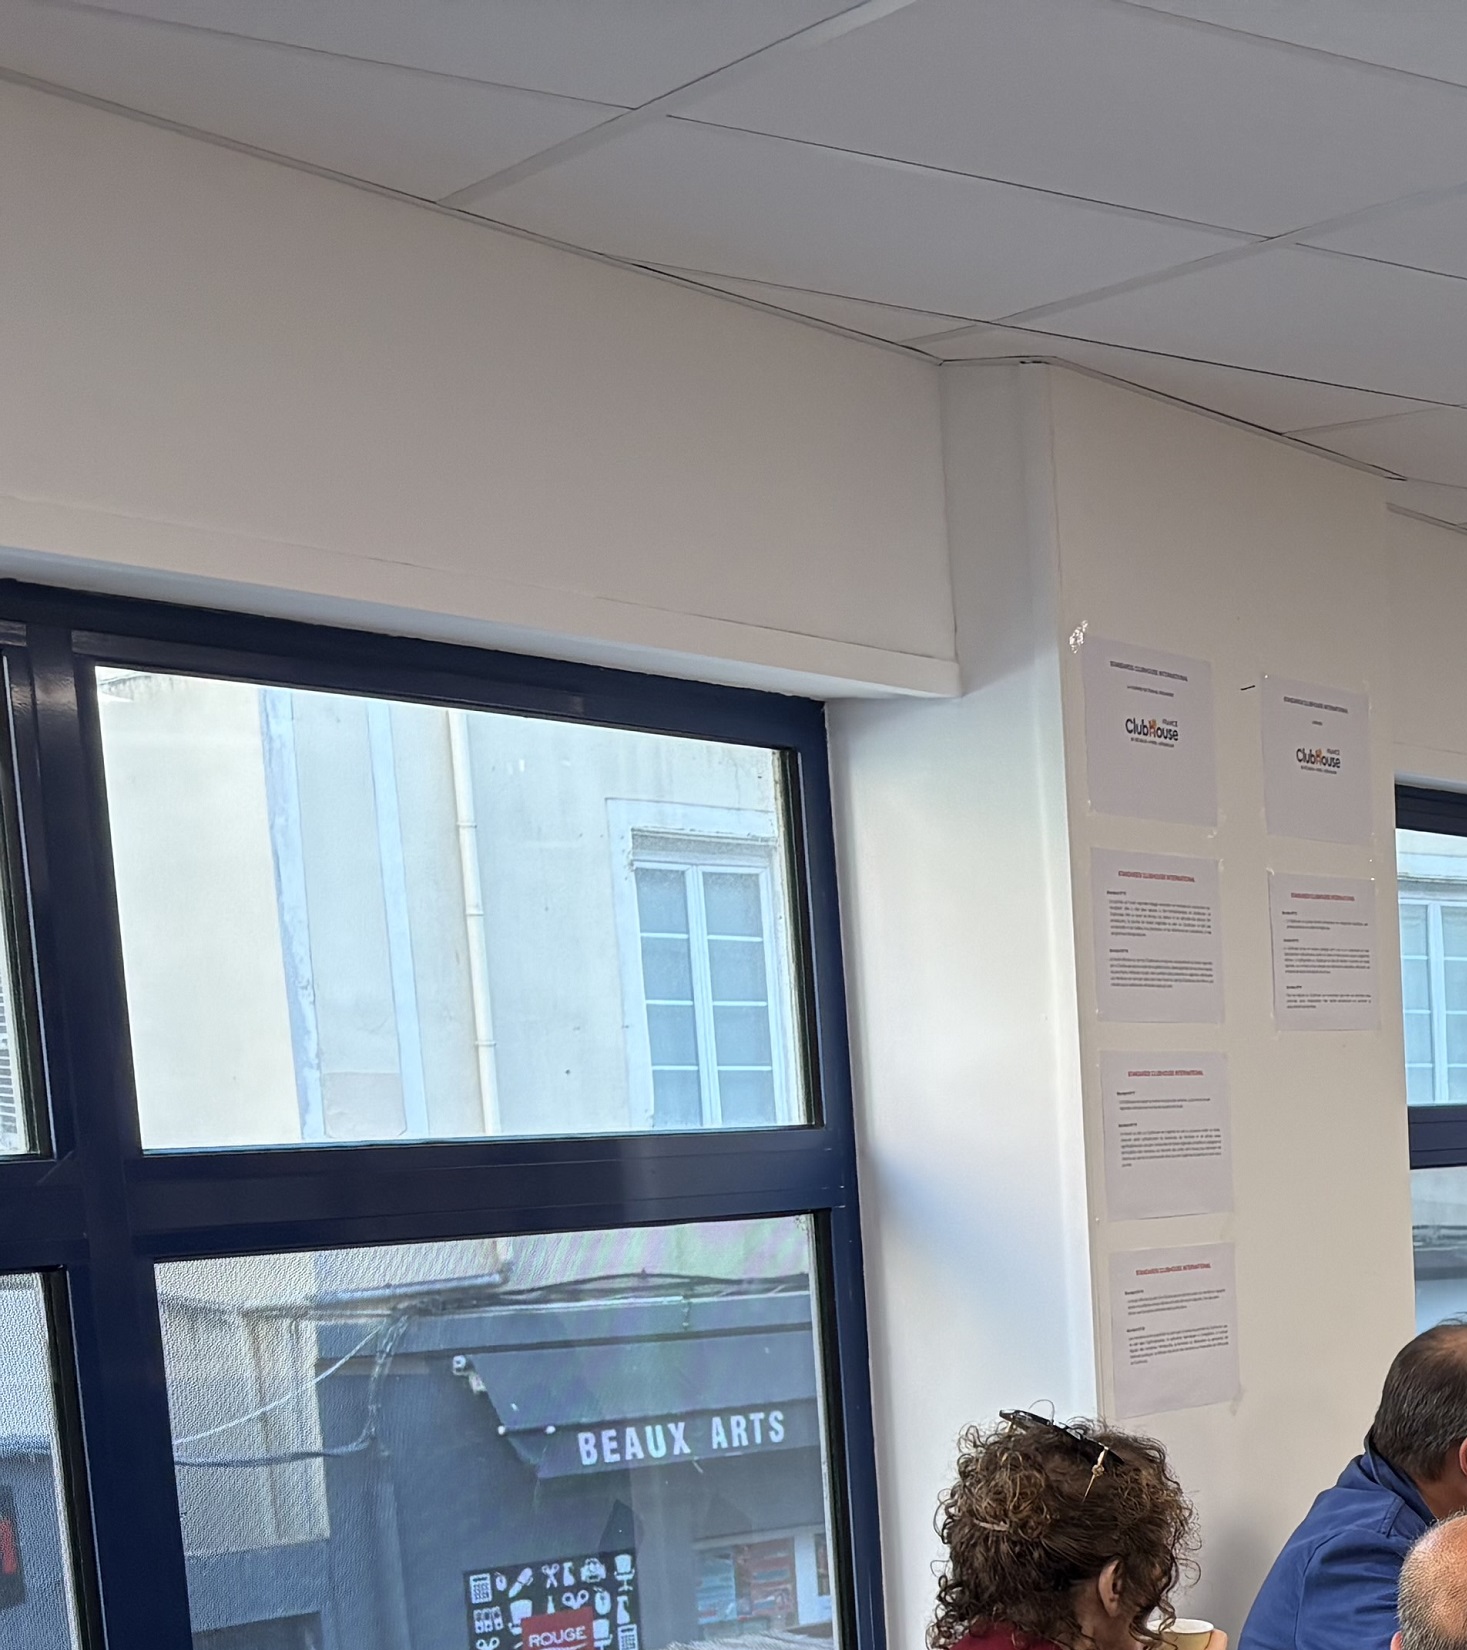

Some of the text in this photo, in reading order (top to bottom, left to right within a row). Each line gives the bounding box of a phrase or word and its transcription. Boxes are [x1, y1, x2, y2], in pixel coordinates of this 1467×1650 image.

[577, 1409, 785, 1467] BEAUX ARTS
[528, 1626, 588, 1649] ROUGE
